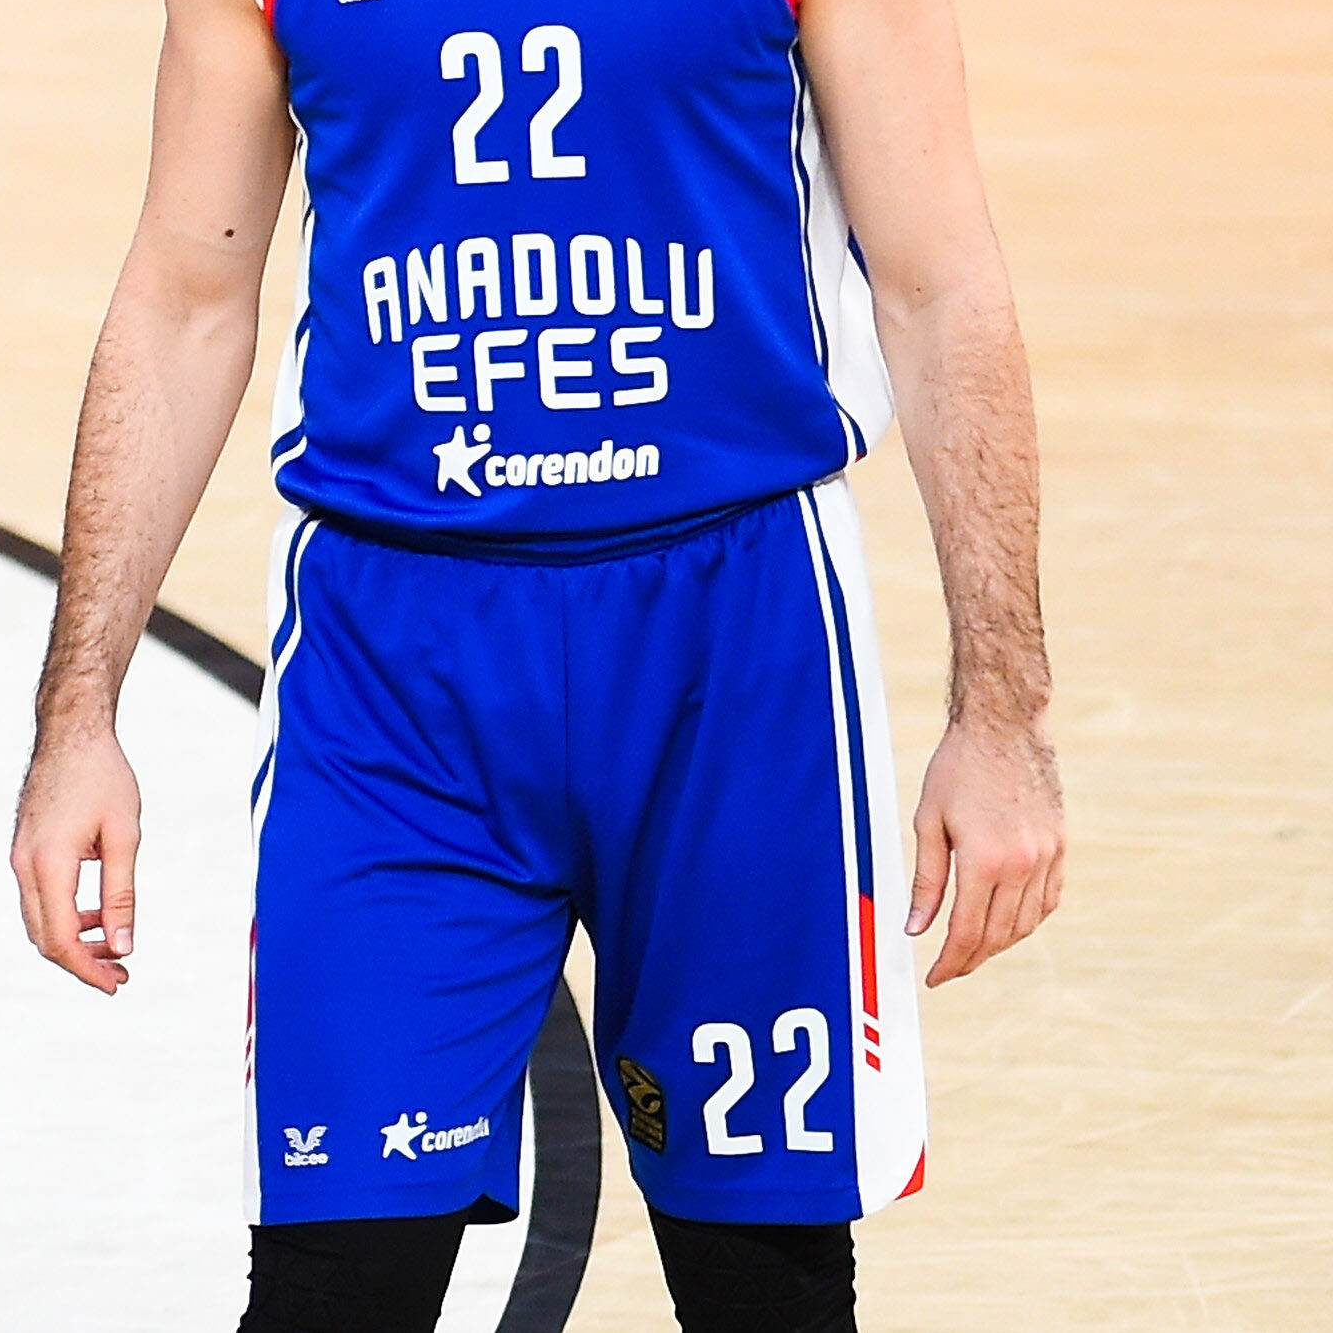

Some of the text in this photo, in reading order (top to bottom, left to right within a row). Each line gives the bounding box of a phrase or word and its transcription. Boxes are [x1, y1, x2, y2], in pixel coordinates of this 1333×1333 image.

[441, 26, 586, 185] 22
[363, 234, 715, 343] ANADOLU
[412, 326, 668, 412] EFES
[485, 439, 660, 486] corendon
[693, 1008, 833, 1156] 22
